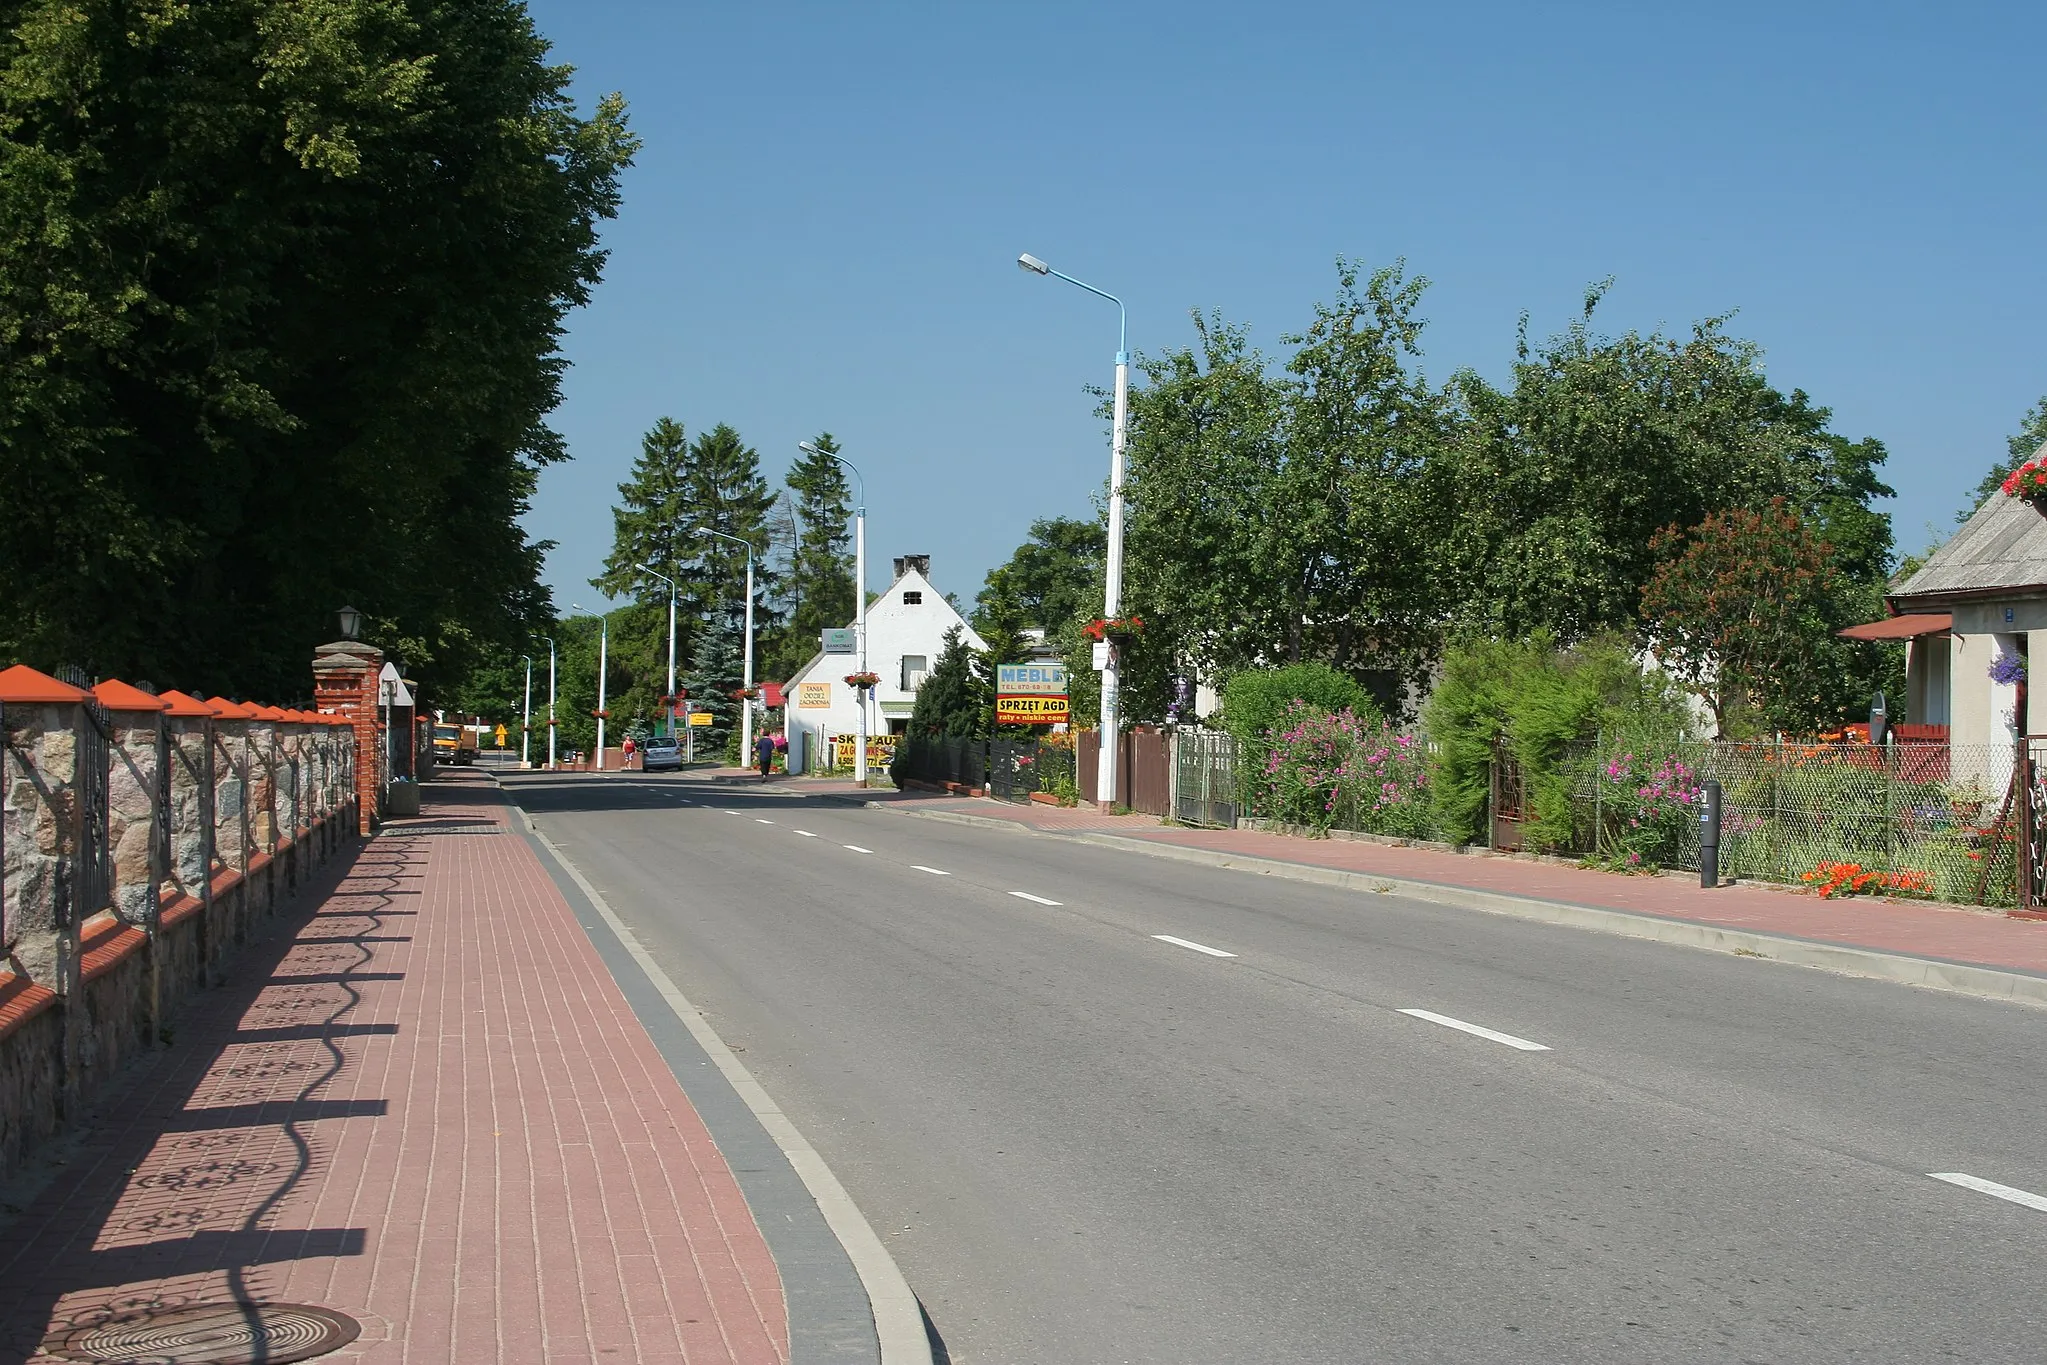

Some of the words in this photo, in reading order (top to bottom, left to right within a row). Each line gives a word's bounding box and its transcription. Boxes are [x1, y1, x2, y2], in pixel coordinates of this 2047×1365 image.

[1000, 700, 1040, 713] SPRZĘT
[1043, 700, 1066, 711] AGD
[1022, 713, 1046, 721] niskie
[1047, 714, 1067, 722] ceny
[838, 735, 872, 744] SKP
[840, 745, 849, 755] ZA
